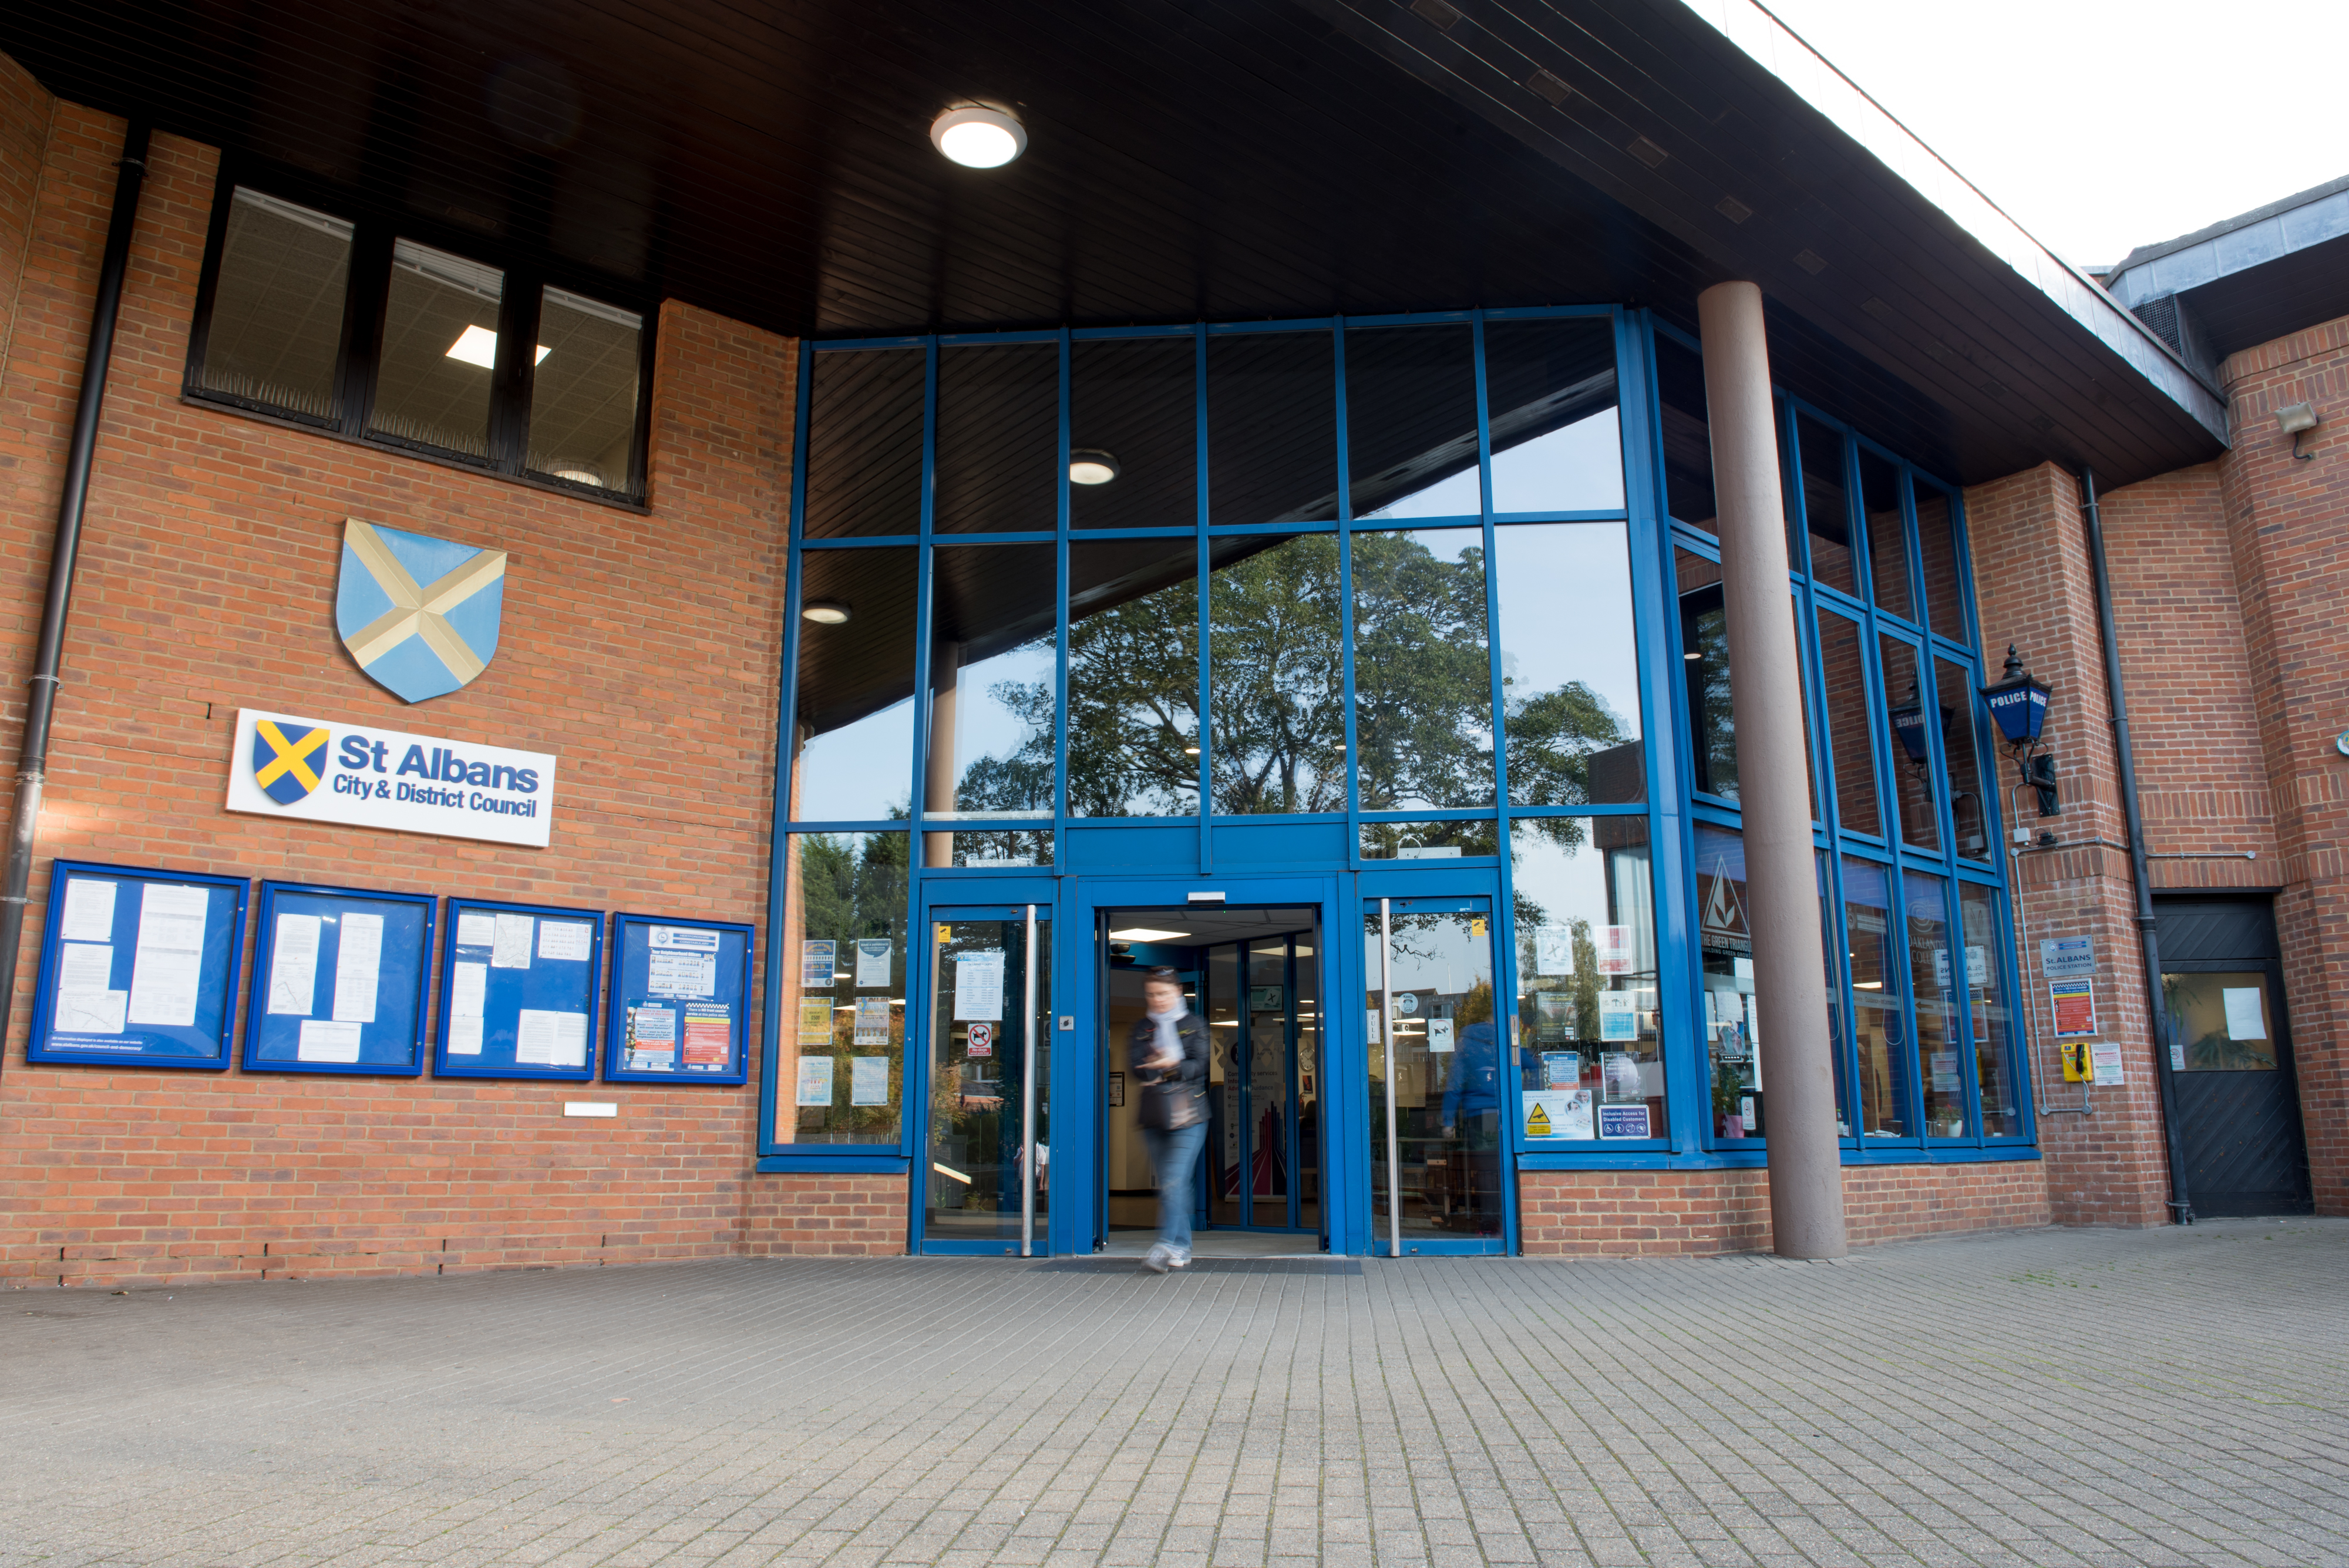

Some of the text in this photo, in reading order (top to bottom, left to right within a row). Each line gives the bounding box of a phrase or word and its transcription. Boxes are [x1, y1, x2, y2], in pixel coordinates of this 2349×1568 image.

[1990, 691, 2027, 708] POLICE
[2030, 691, 2046, 707] POLICE
[338, 735, 539, 793] St Albans
[334, 774, 536, 817] City & District Council
[1701, 933, 1711, 945] THE
[1711, 935, 1728, 948] GREEN
[1908, 935, 1944, 950] OAKLANDS
[1911, 950, 1935, 964] COLLE
[2057, 954, 2091, 963] ALBANS
[51, 1042, 143, 1051] www.stalbans.gov.uk/council-and-democracy/
